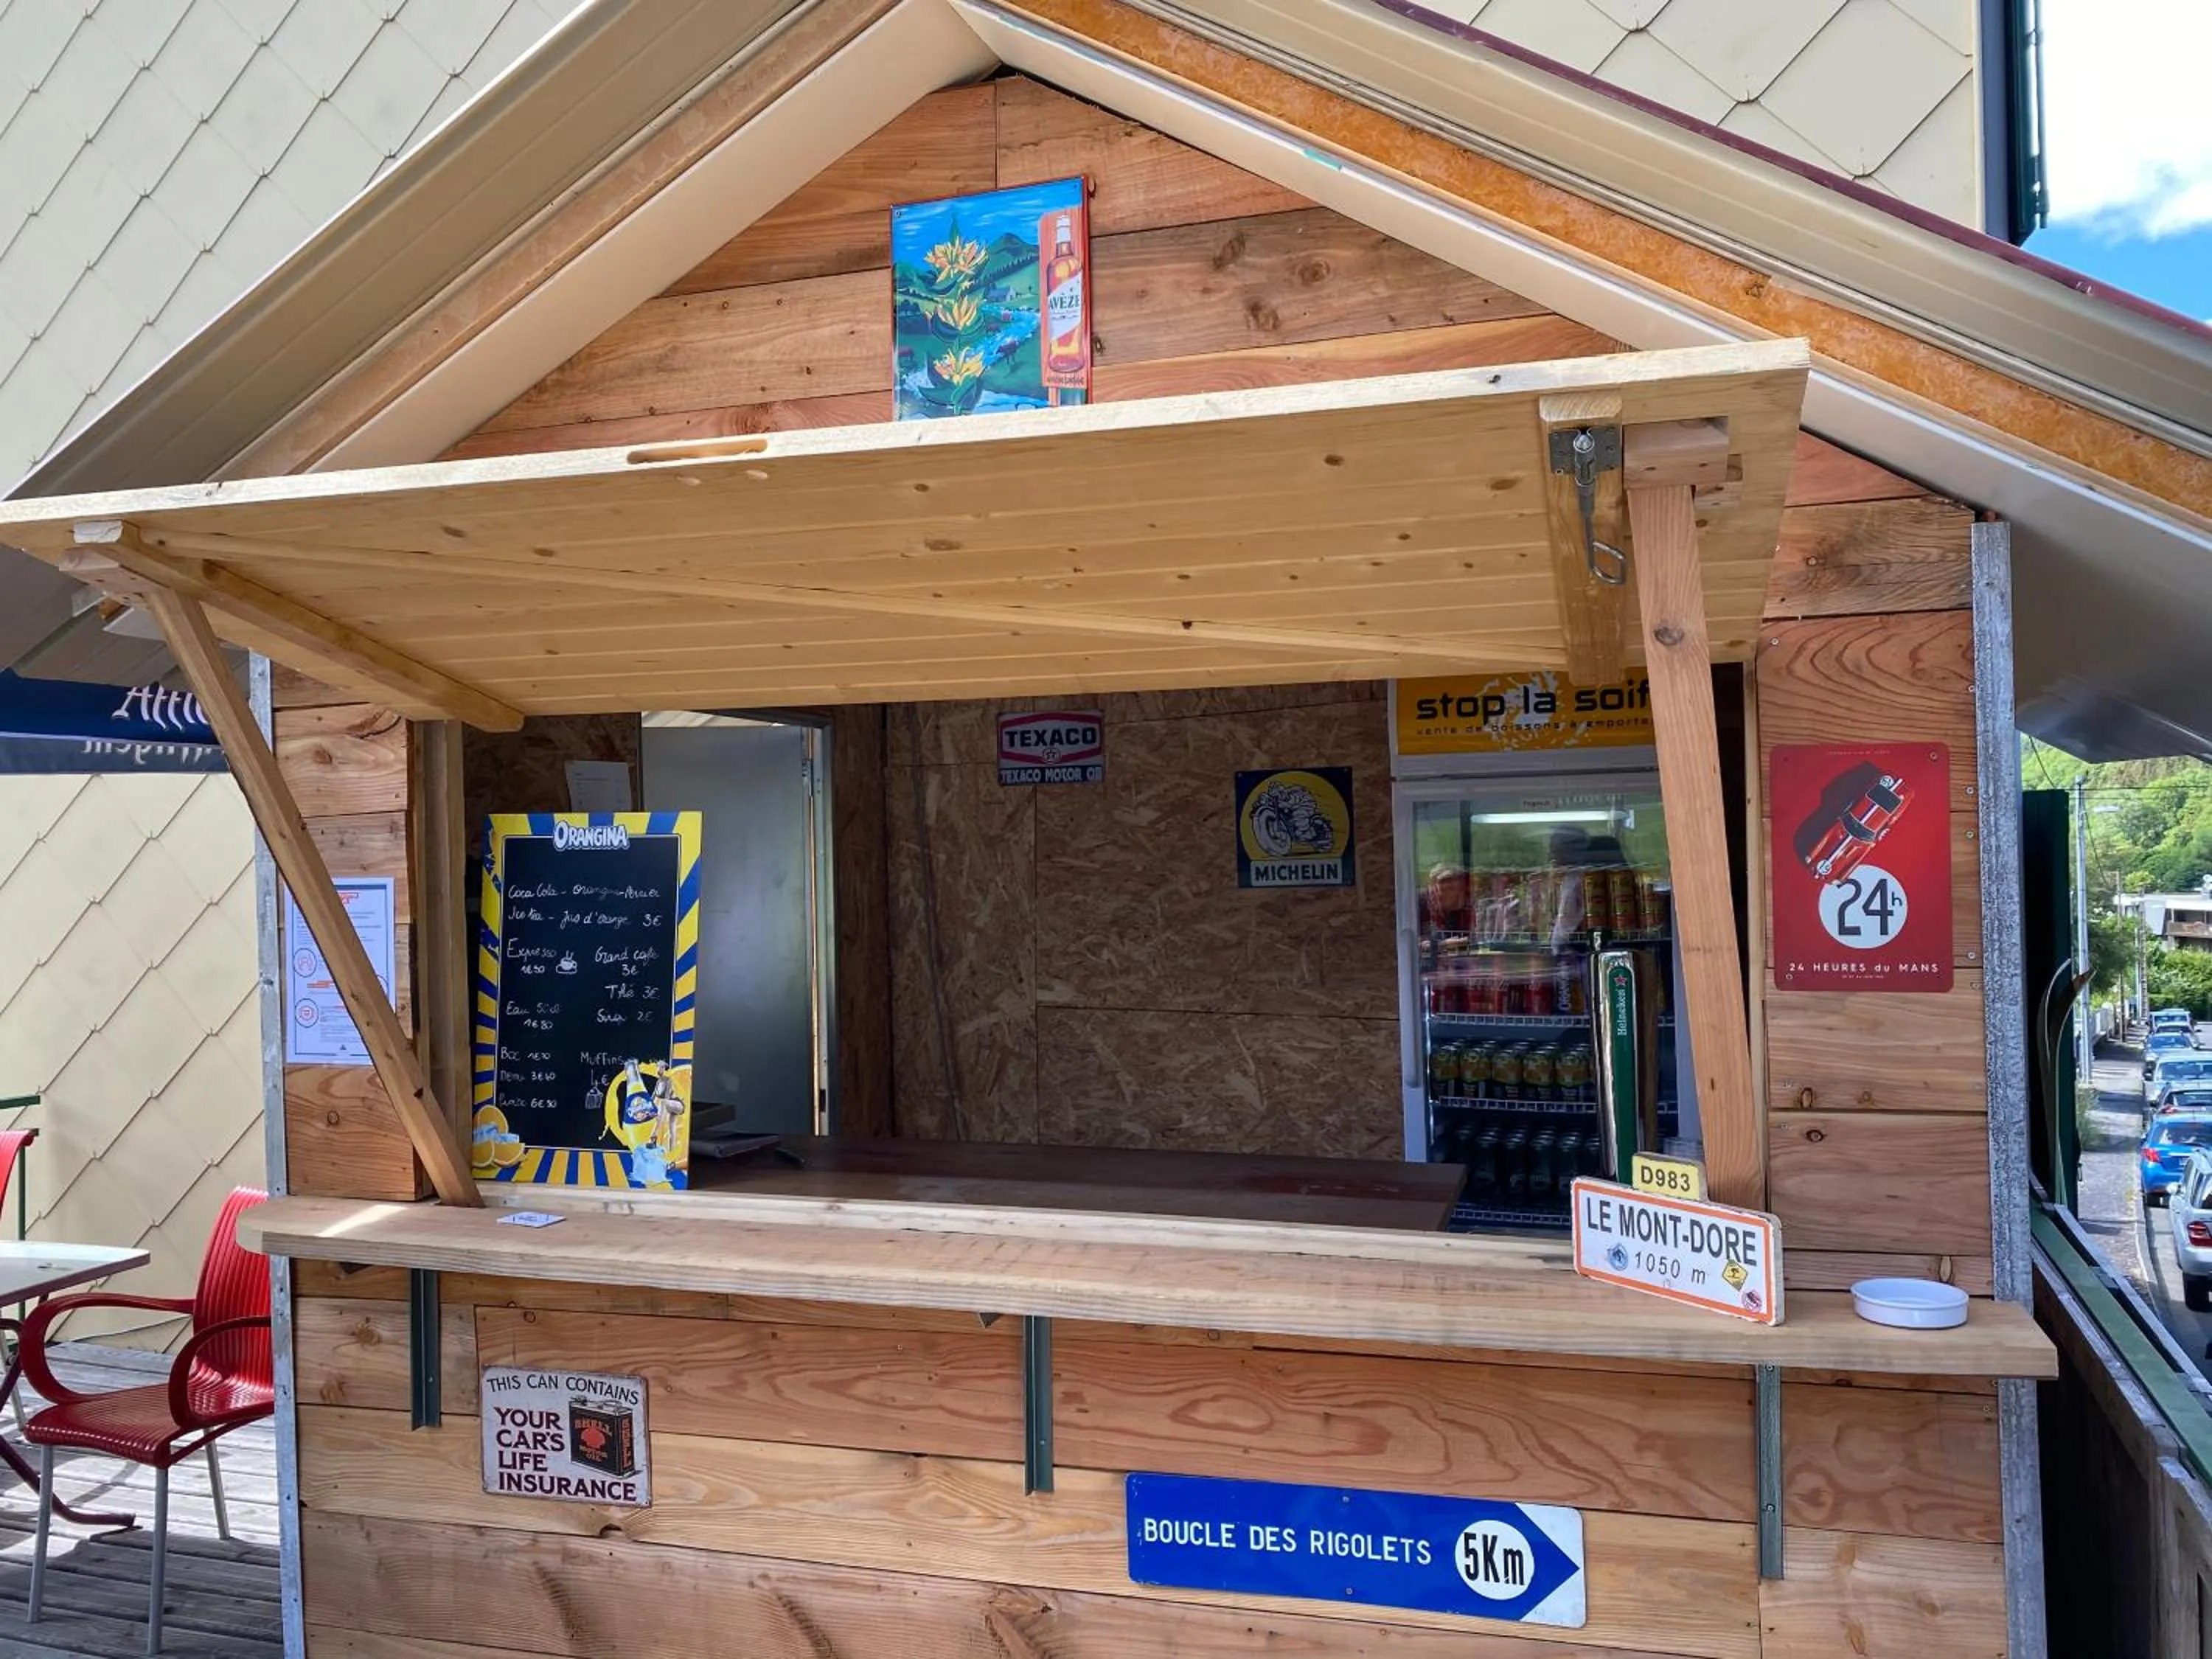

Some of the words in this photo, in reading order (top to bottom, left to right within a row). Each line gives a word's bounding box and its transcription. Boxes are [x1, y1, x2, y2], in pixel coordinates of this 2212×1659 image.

[1416, 692, 1505, 725] stop
[1523, 686, 1557, 714] la
[1574, 679, 1650, 712] soif
[1004, 726, 1096, 748] TEXACO
[1417, 726, 1457, 735] vente
[1465, 724, 1483, 734] de
[1492, 721, 1559, 732] boissons
[1586, 717, 1654, 730] emporte
[1000, 768, 1041, 784] TEXACO
[1046, 766, 1082, 782] MOTOR
[555, 820, 628, 849] ORANGINA
[1255, 861, 1338, 883] MICHELIN
[1790, 962, 1804, 972] 24
[1813, 962, 1866, 973] HEURES
[1874, 962, 1891, 973] du
[1899, 962, 1939, 973] MANS
[1641, 1165, 1691, 1192] D983
[1587, 1196, 1612, 1233] LE
[1619, 1203, 1757, 1266] MONT-DORE
[1635, 1251, 1680, 1279] 1050
[1691, 1267, 1706, 1284] m
[487, 1375, 521, 1393] THIS
[526, 1374, 559, 1390] CAN
[566, 1376, 639, 1405] CONTAINS
[494, 1407, 564, 1431] YOUR
[496, 1429, 566, 1453] CAR'S
[498, 1450, 548, 1472] LIFE
[498, 1471, 637, 1502] INSURANCE
[1144, 1517, 1237, 1548] BOUCLE
[1250, 1525, 1298, 1552] DES
[1310, 1531, 1433, 1565] RIGOLETS
